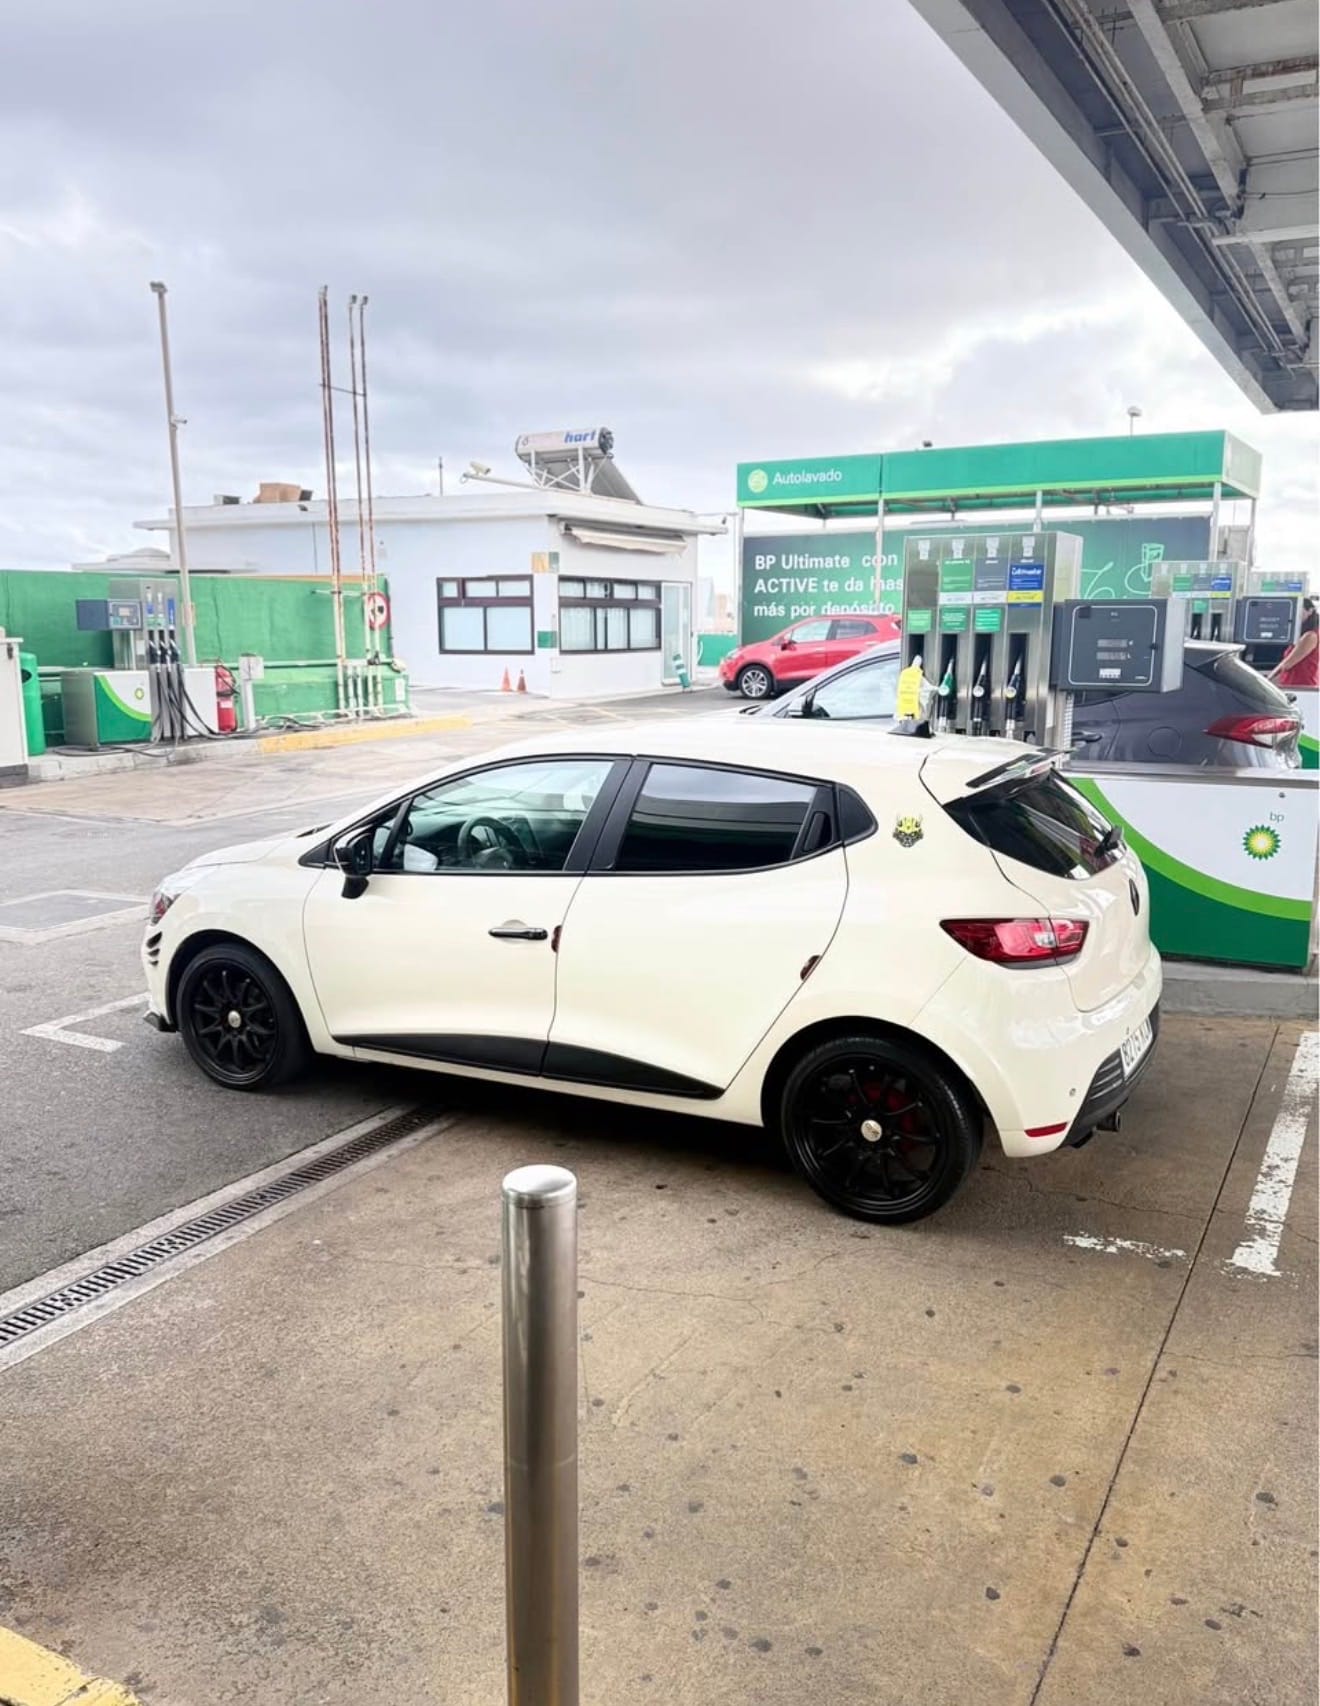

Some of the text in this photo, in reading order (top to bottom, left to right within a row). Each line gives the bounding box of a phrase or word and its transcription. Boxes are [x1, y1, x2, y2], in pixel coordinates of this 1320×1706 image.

[772, 468, 843, 485] Autolavado
[754, 553, 898, 570] BP Ultimate con
[754, 577, 819, 594] ACTIVE
[823, 579, 839, 592] te
[844, 577, 864, 592] da
[753, 602, 786, 617] más
[790, 604, 815, 620] por
[1269, 811, 1285, 823] bp
